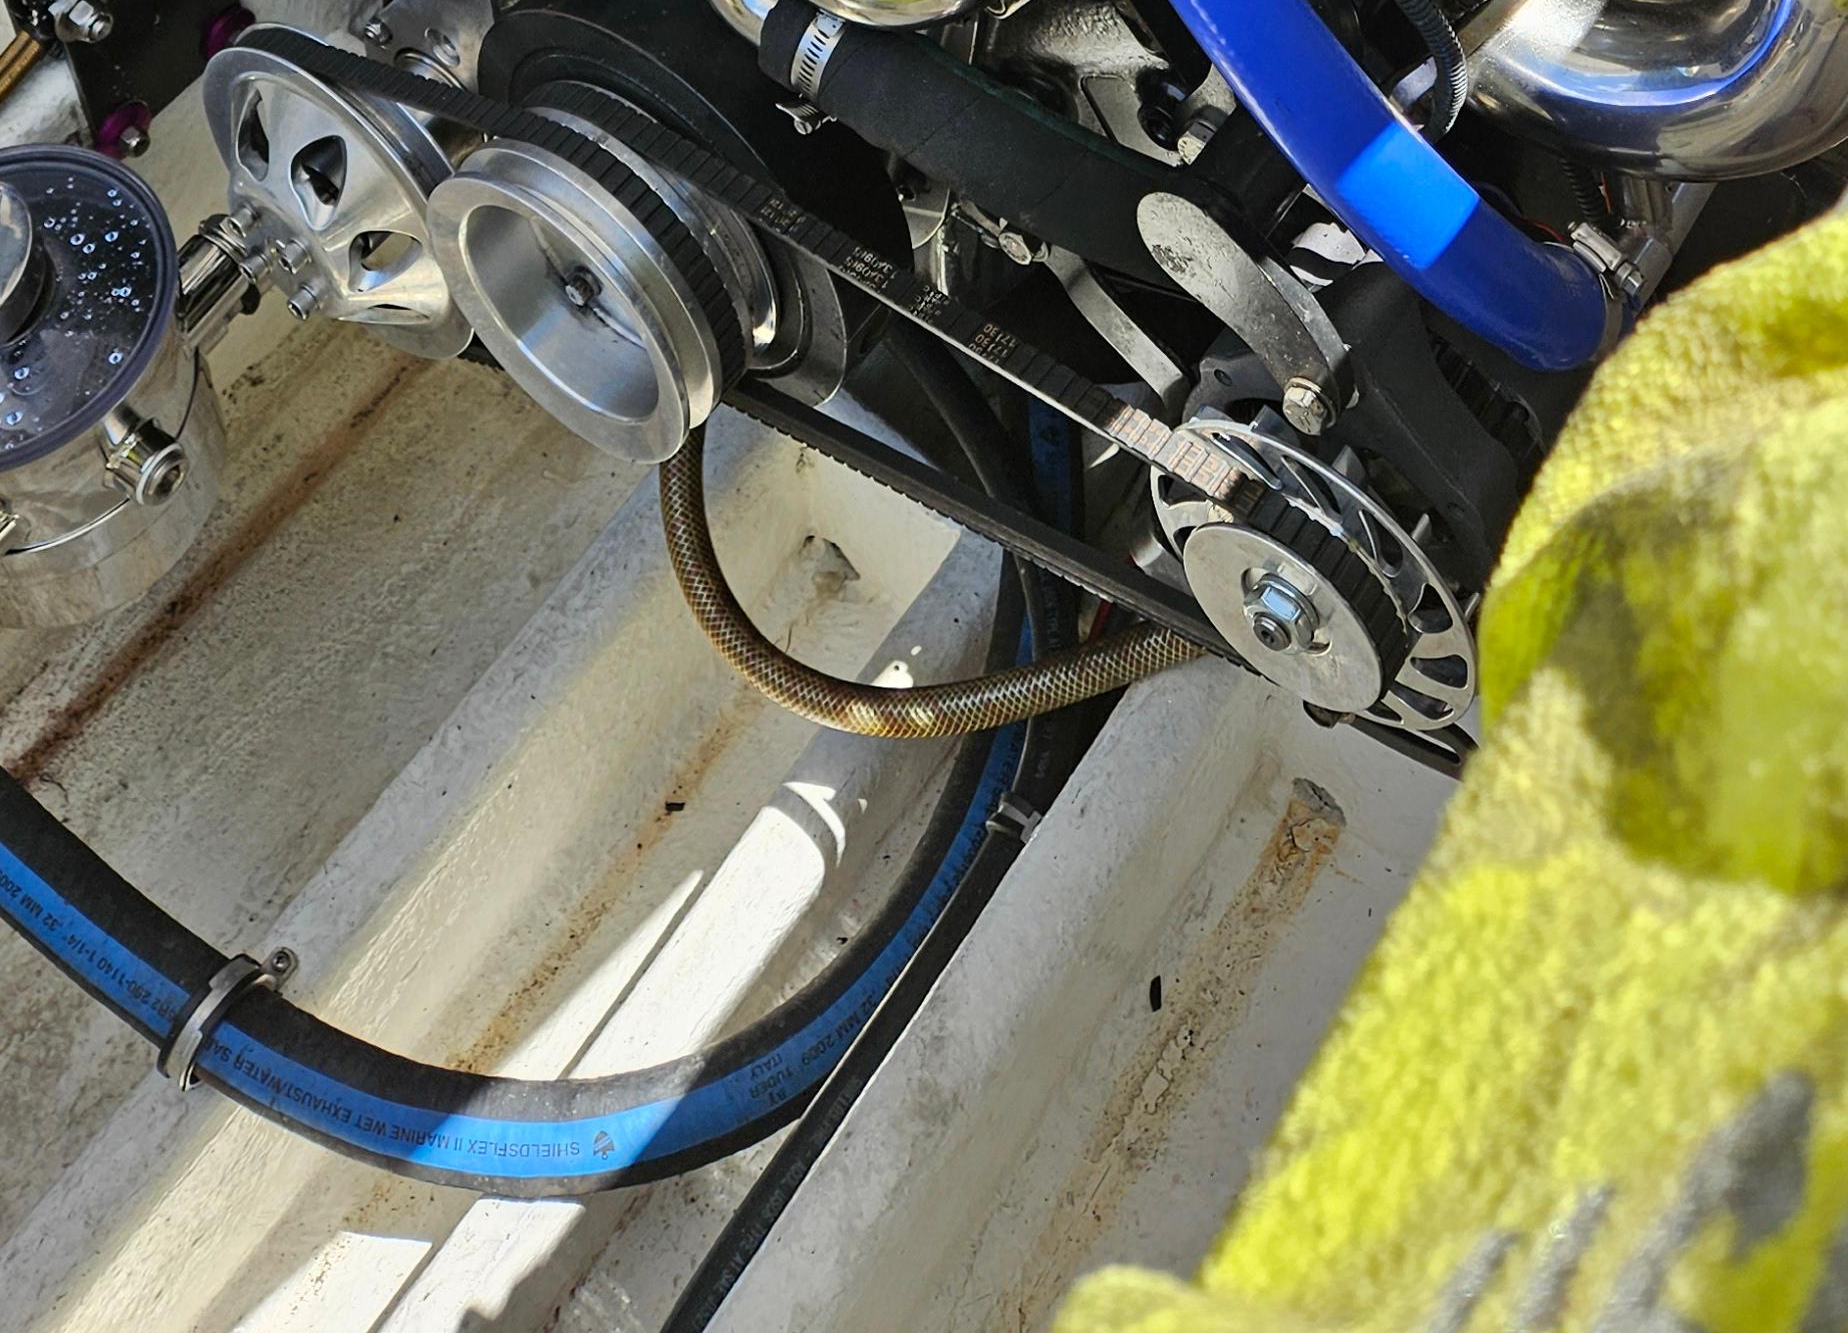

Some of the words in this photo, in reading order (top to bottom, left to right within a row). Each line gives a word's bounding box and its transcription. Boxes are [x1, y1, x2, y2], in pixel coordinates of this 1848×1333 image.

[0, 869, 22, 899] 200
[18, 893, 44, 918] MM
[748, 1052, 784, 1080] ITALY
[353, 1113, 387, 1137] WET
[389, 1124, 450, 1150] MARINE
[453, 1136, 463, 1152] II
[466, 1138, 580, 1155] SHIELDSFLEX
